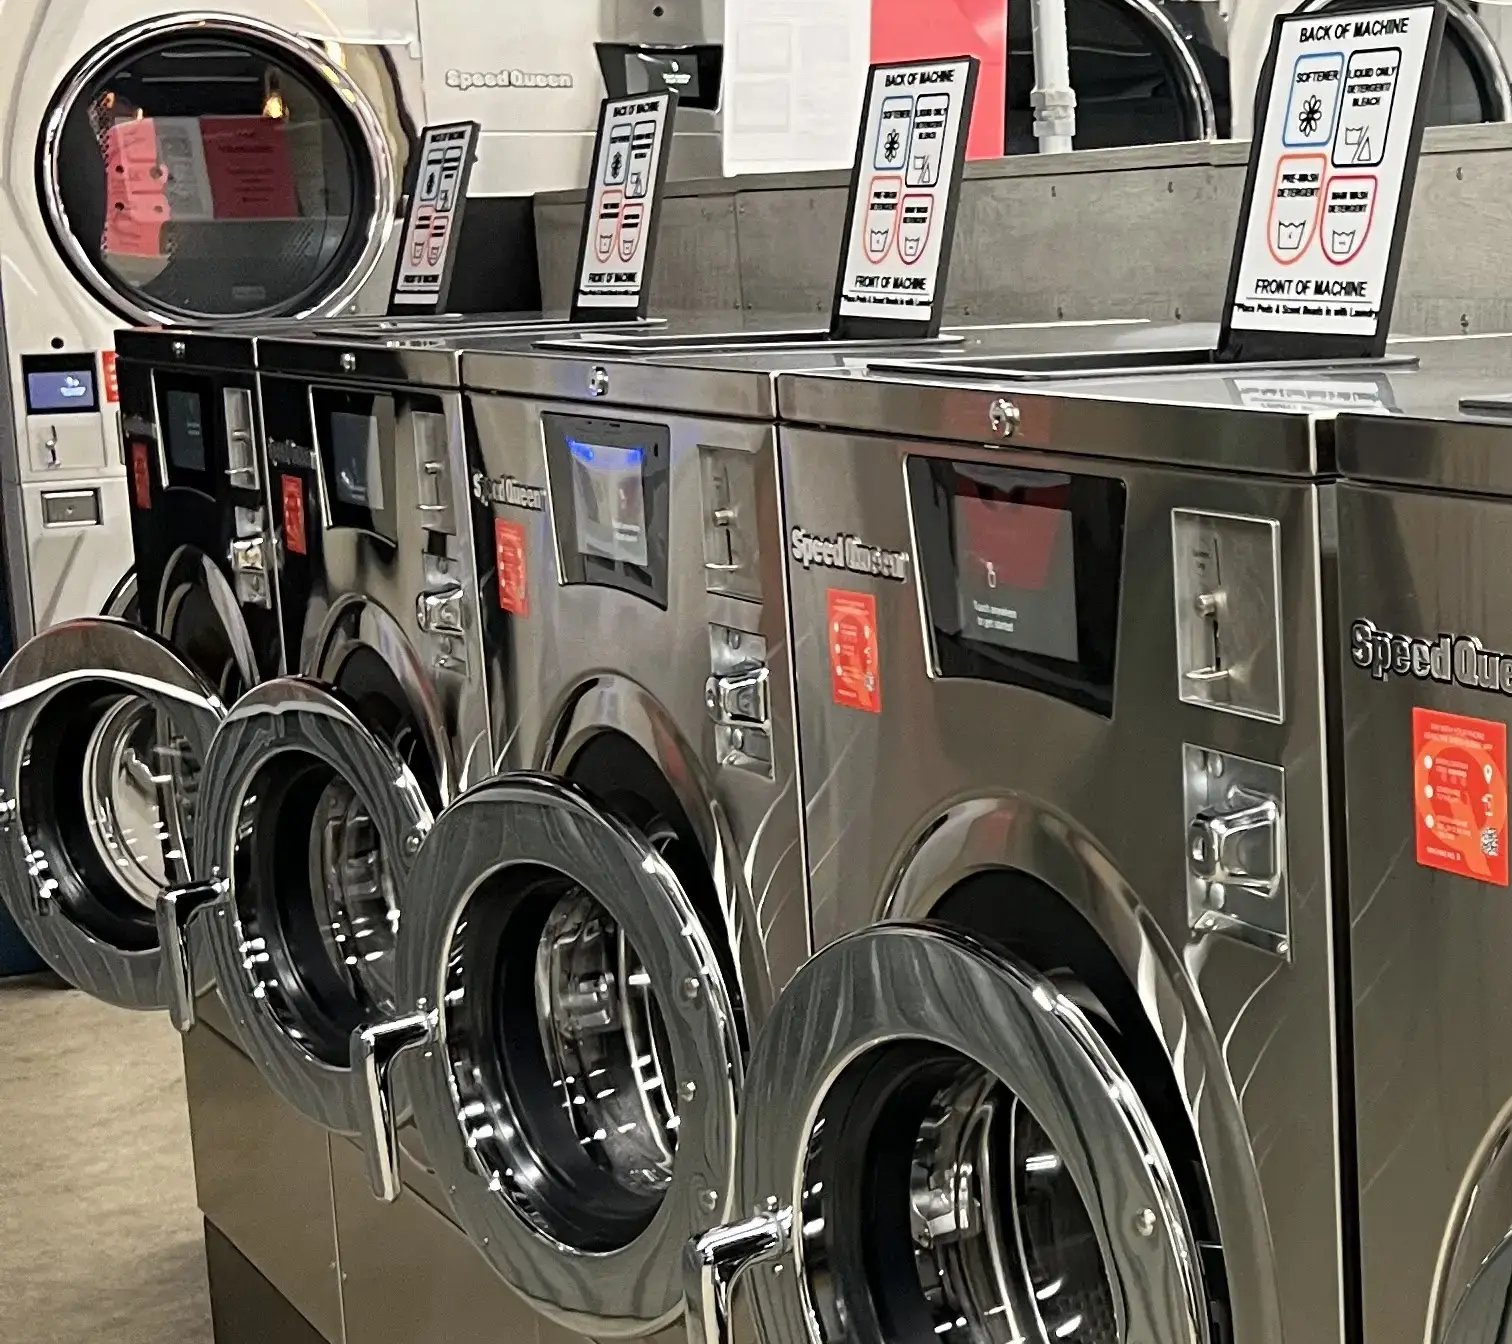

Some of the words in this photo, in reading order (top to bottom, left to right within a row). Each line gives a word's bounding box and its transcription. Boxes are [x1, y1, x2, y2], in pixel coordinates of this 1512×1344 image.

[1299, 25, 1330, 43] BACK
[1334, 23, 1351, 39] OF
[1352, 17, 1410, 38] MACHINE
[445, 69, 510, 91] Speed
[510, 68, 573, 89] Queen
[1254, 278, 1294, 295] FRONT
[1295, 279, 1312, 296] OF
[1314, 280, 1368, 297] MACHINE
[791, 525, 845, 571] Speed
[1352, 618, 1455, 682] Speed
